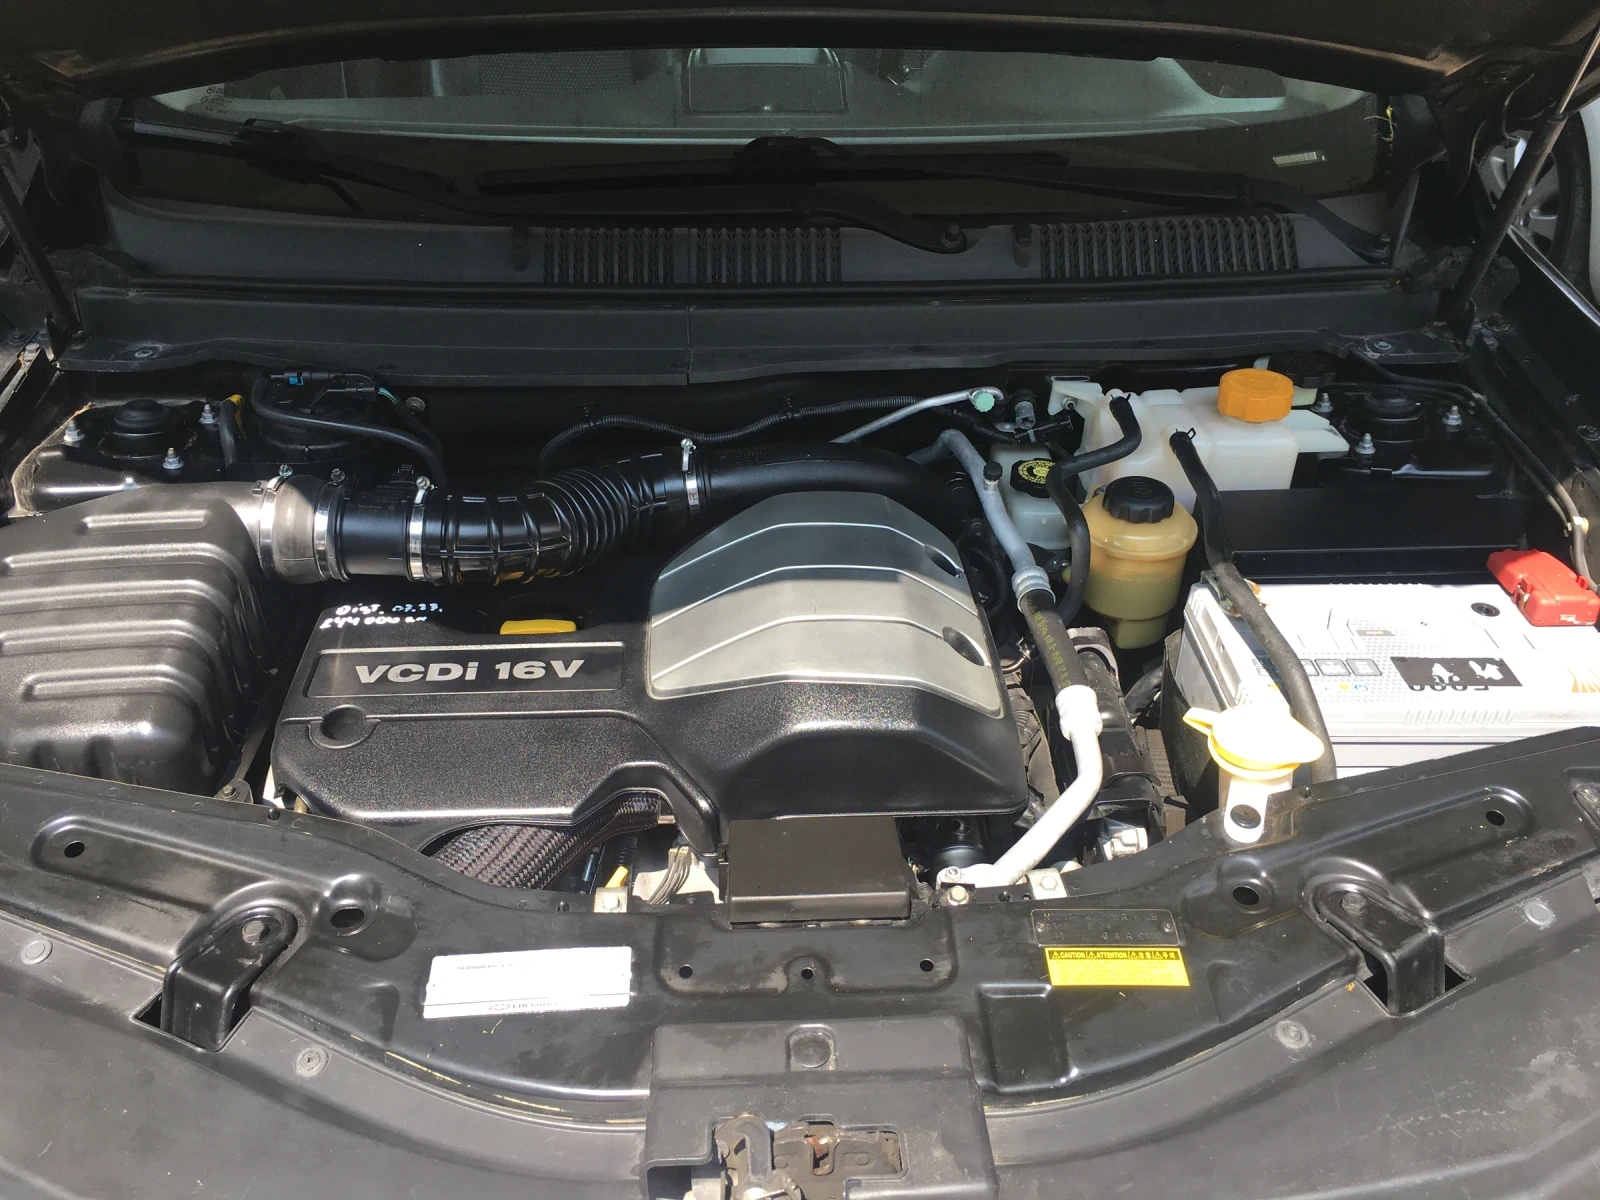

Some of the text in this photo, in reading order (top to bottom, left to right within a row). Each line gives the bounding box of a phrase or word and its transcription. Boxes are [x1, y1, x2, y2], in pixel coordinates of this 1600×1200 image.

[355, 659, 585, 684] VCDi 16V
[1060, 951, 1128, 959] CAUTION ATTENTION
